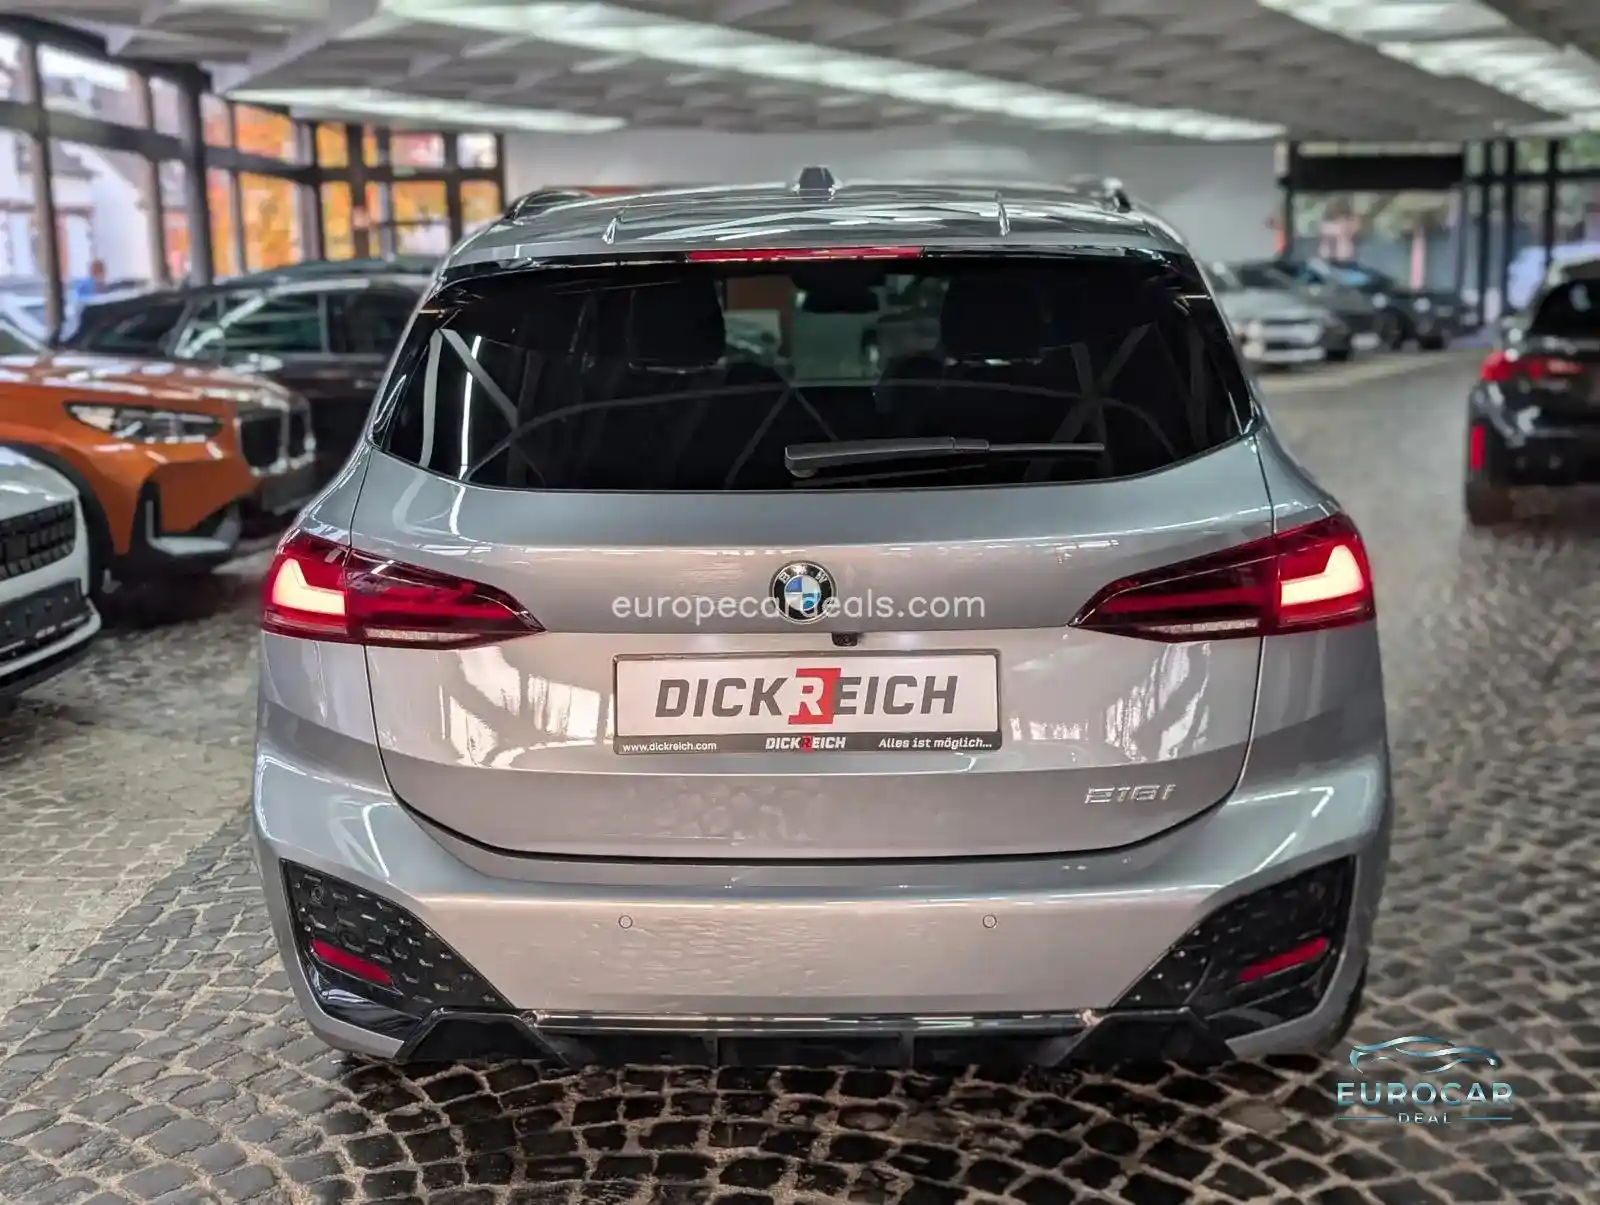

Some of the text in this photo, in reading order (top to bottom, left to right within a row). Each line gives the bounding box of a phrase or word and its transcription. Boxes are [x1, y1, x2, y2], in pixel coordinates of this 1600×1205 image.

[654, 668, 958, 724] DICKREICH
[622, 741, 717, 752] www.dickreich.com
[765, 736, 847, 751] DICKREICH
[878, 736, 993, 750] Alles ist möglich...
